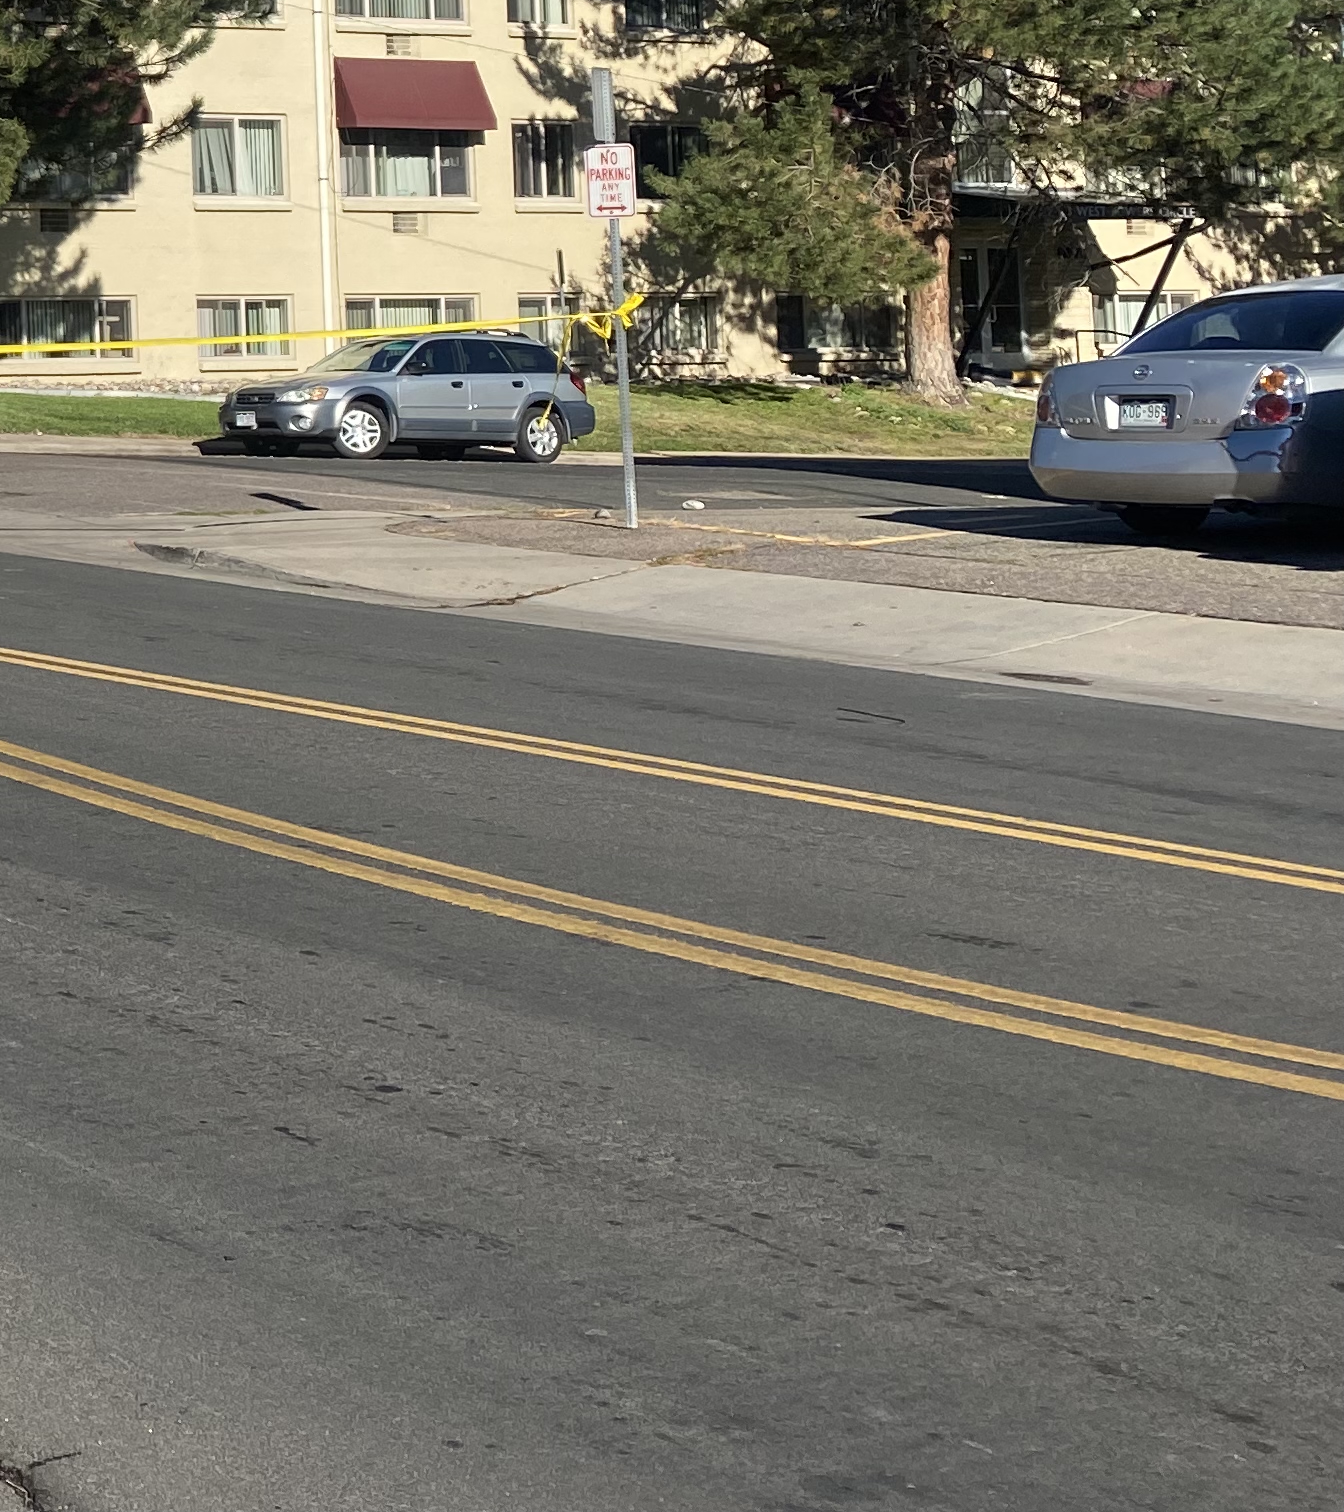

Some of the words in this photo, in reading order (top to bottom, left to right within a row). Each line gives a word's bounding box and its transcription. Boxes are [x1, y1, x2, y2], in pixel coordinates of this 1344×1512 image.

[600, 151, 618, 165] NO
[589, 168, 631, 181] PARKING
[602, 182, 620, 192] ANY
[600, 194, 623, 202] TIME
[1076, 206, 1106, 217] WEST
